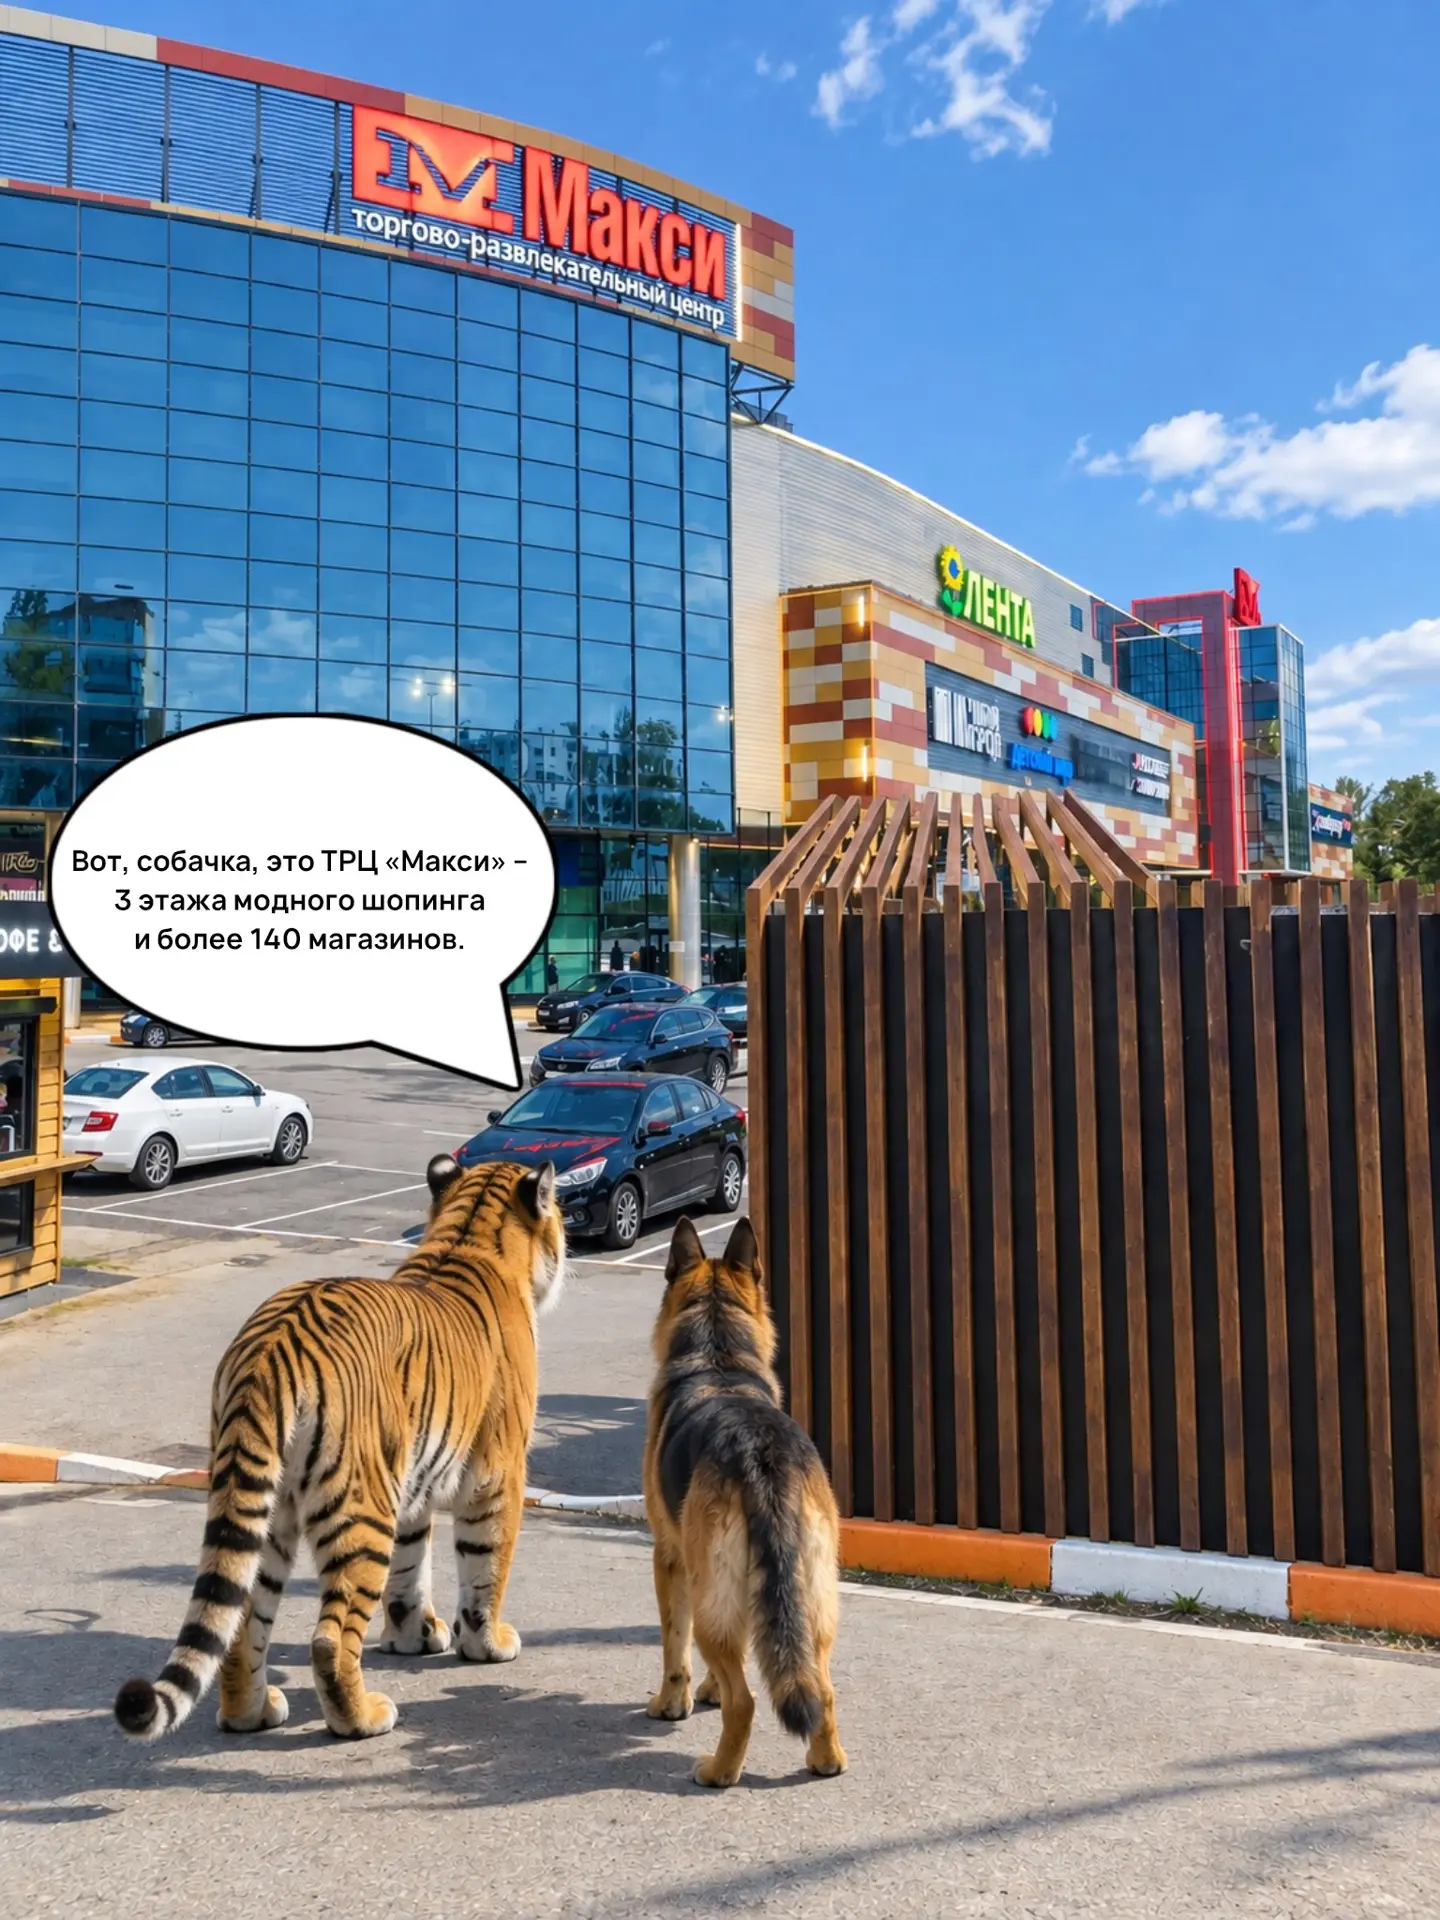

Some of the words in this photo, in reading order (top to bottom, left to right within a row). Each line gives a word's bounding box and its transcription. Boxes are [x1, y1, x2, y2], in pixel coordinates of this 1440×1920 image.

[351, 208, 667, 307] торгово-развлекательный
[670, 291, 725, 330] центр
[523, 144, 727, 301] Макси
[963, 569, 1036, 649] ЛЕНТА
